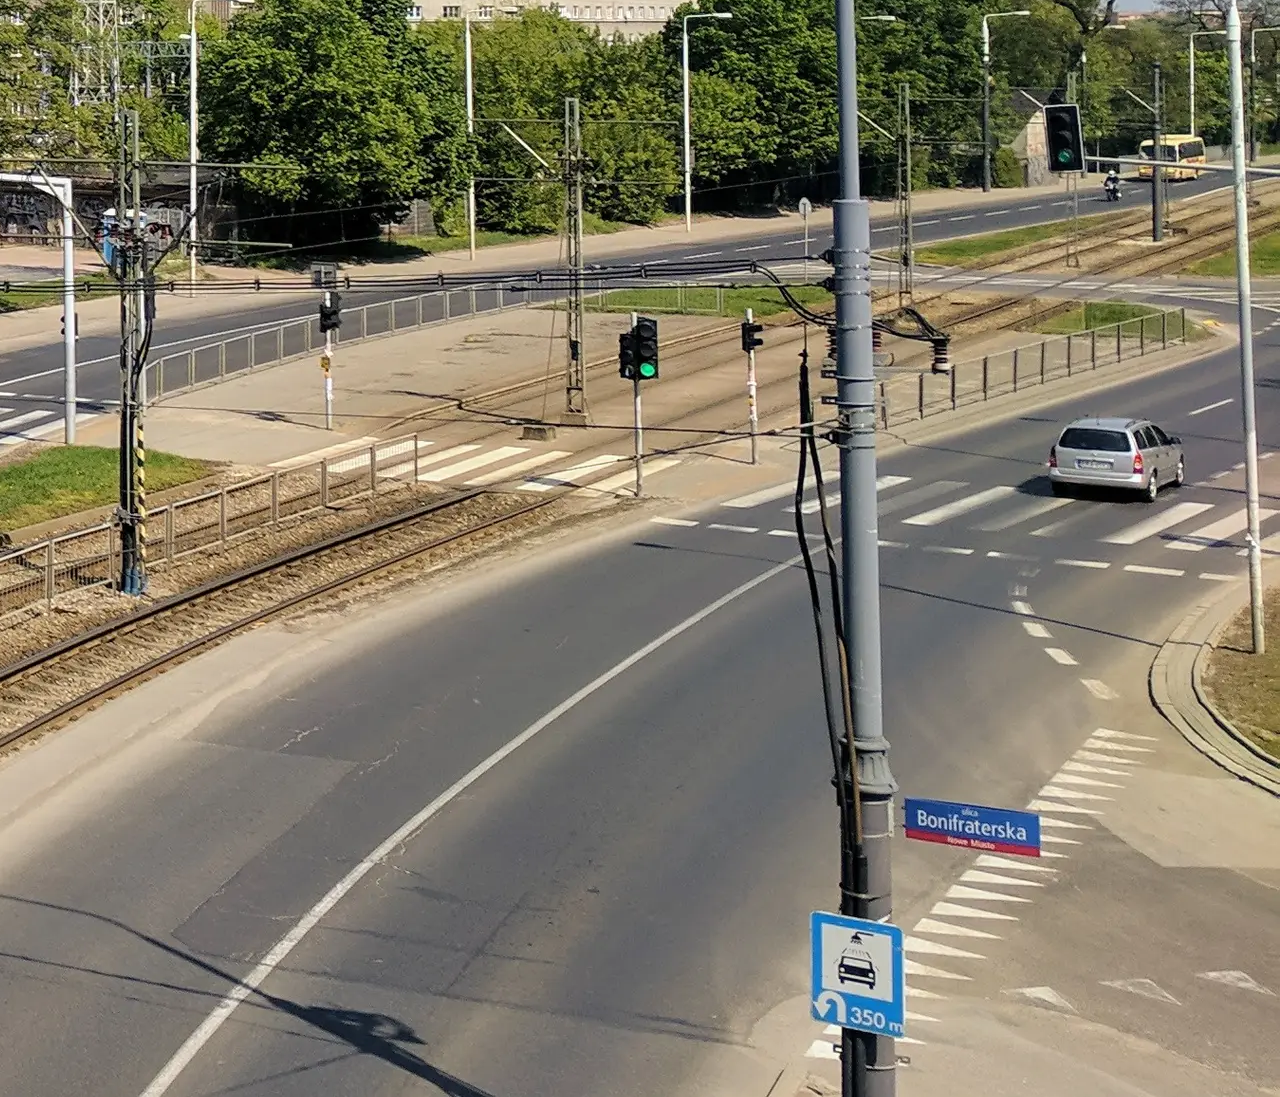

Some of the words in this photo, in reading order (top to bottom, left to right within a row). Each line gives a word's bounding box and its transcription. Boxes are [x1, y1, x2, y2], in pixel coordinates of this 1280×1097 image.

[916, 809, 1027, 841] Bonifraterska
[850, 1006, 886, 1029] 350
[889, 1022, 903, 1033] m
